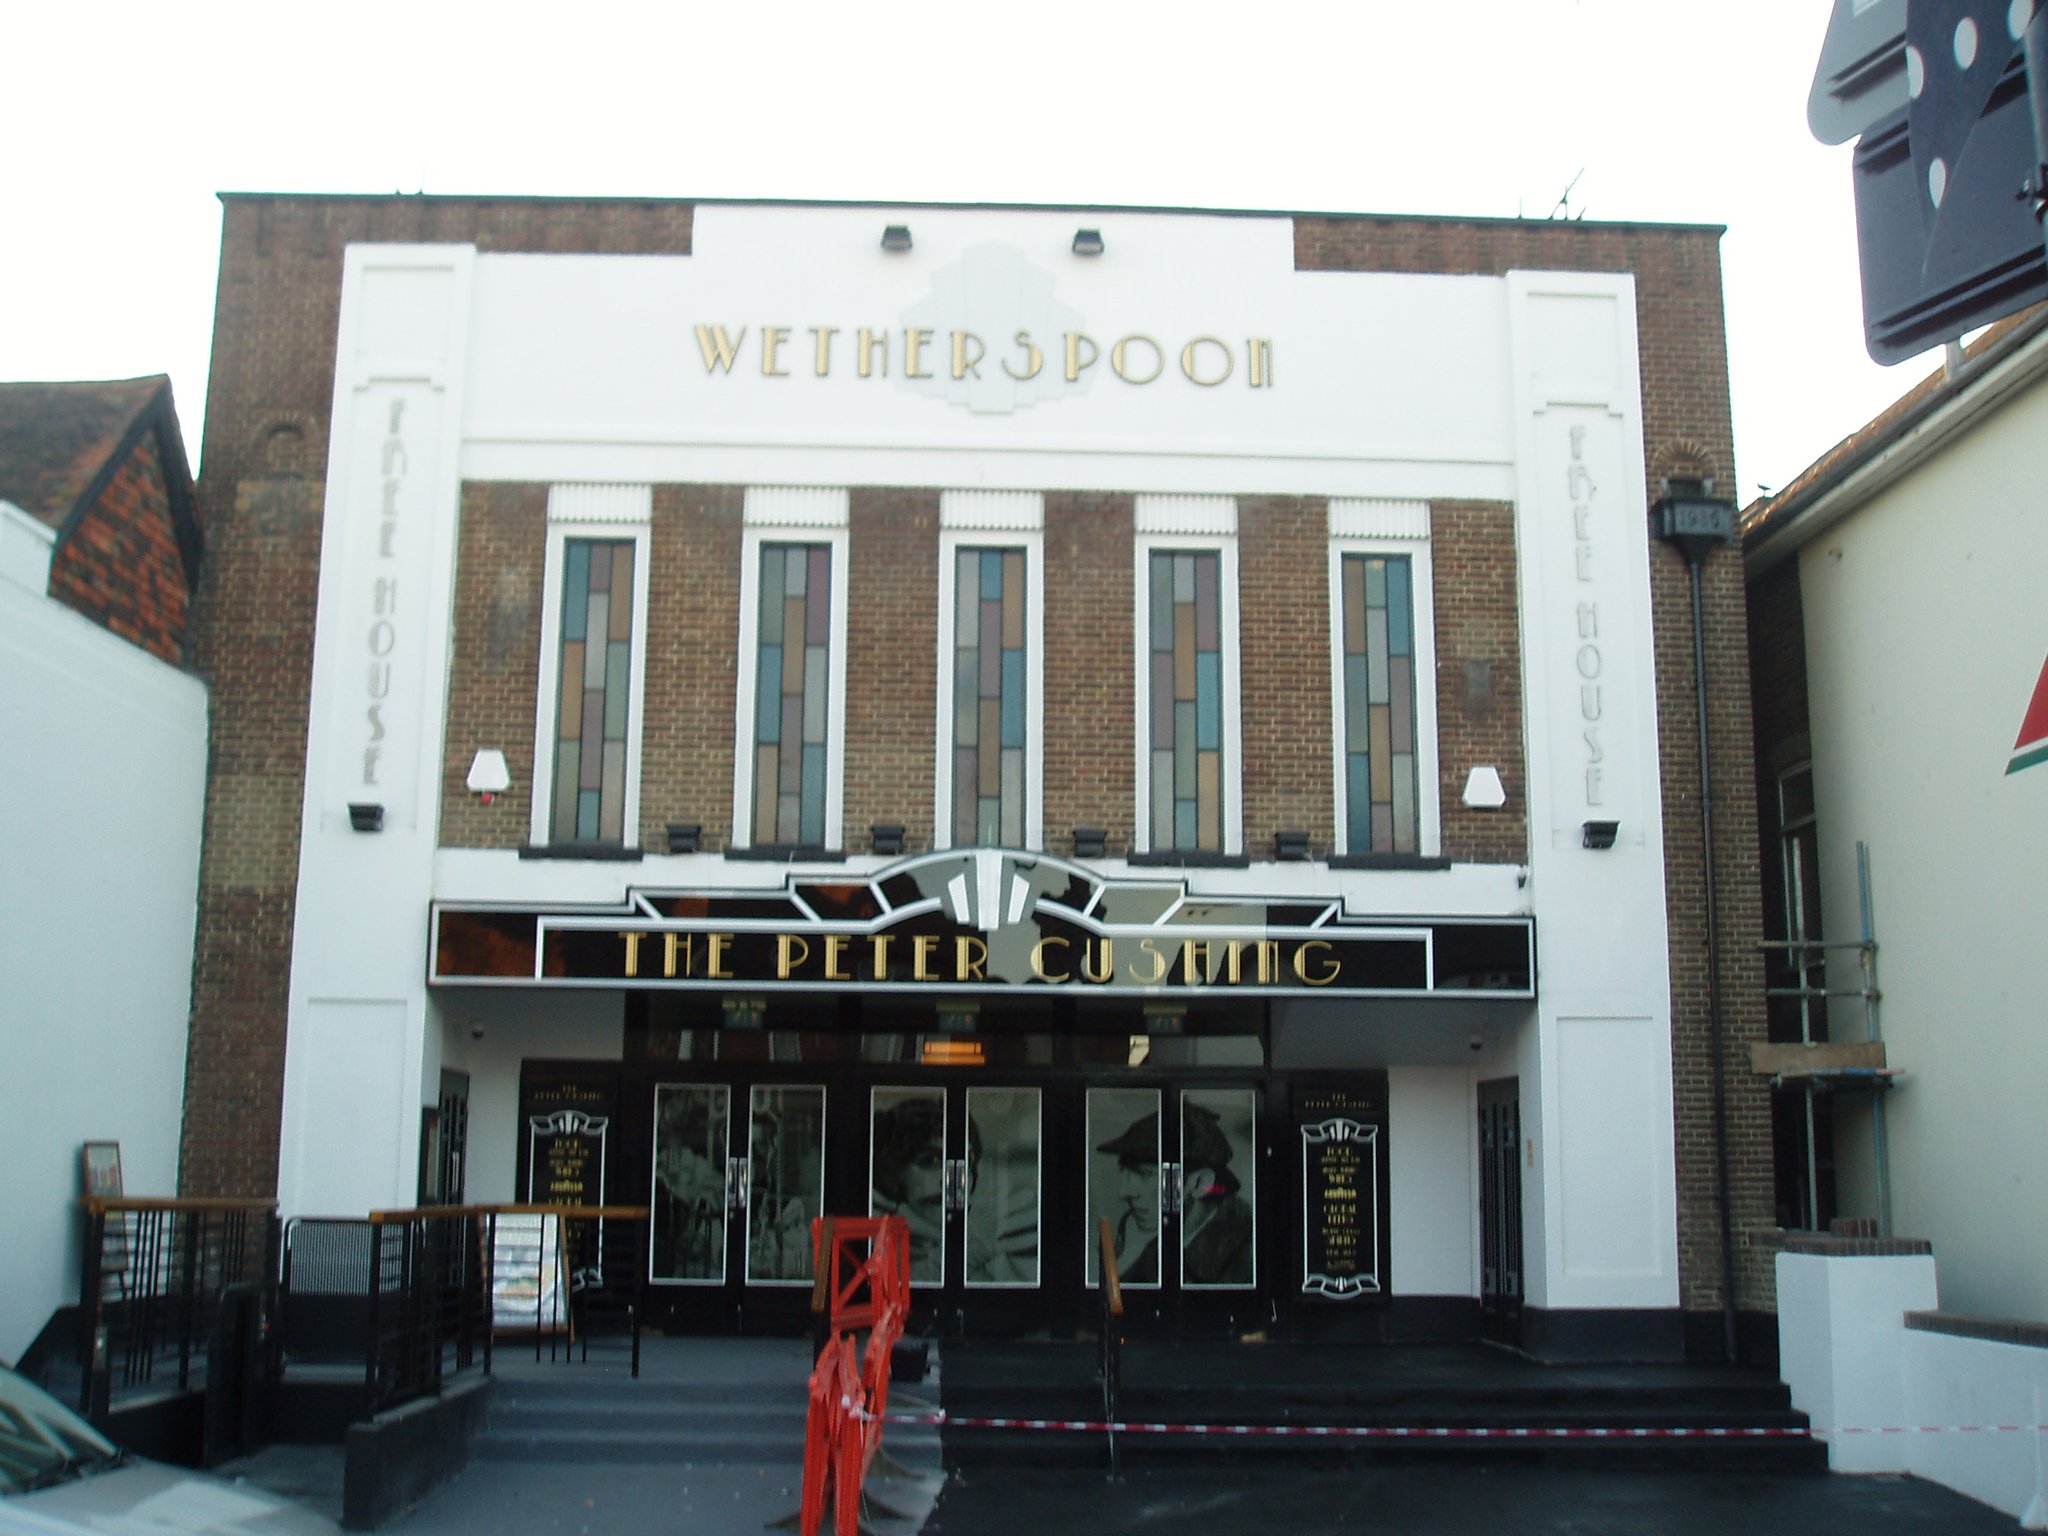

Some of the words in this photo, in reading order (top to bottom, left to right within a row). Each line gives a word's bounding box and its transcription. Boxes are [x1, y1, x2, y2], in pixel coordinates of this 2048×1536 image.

[693, 324, 1274, 389] WETHERSPOON
[378, 398, 408, 559] FREE
[1568, 425, 1597, 582] FREE
[363, 576, 397, 786] HOUSE
[1575, 601, 1603, 807] HOUSE
[618, 931, 735, 978] THE
[775, 933, 989, 982] PETER
[1030, 936, 1342, 986] CUSHING
